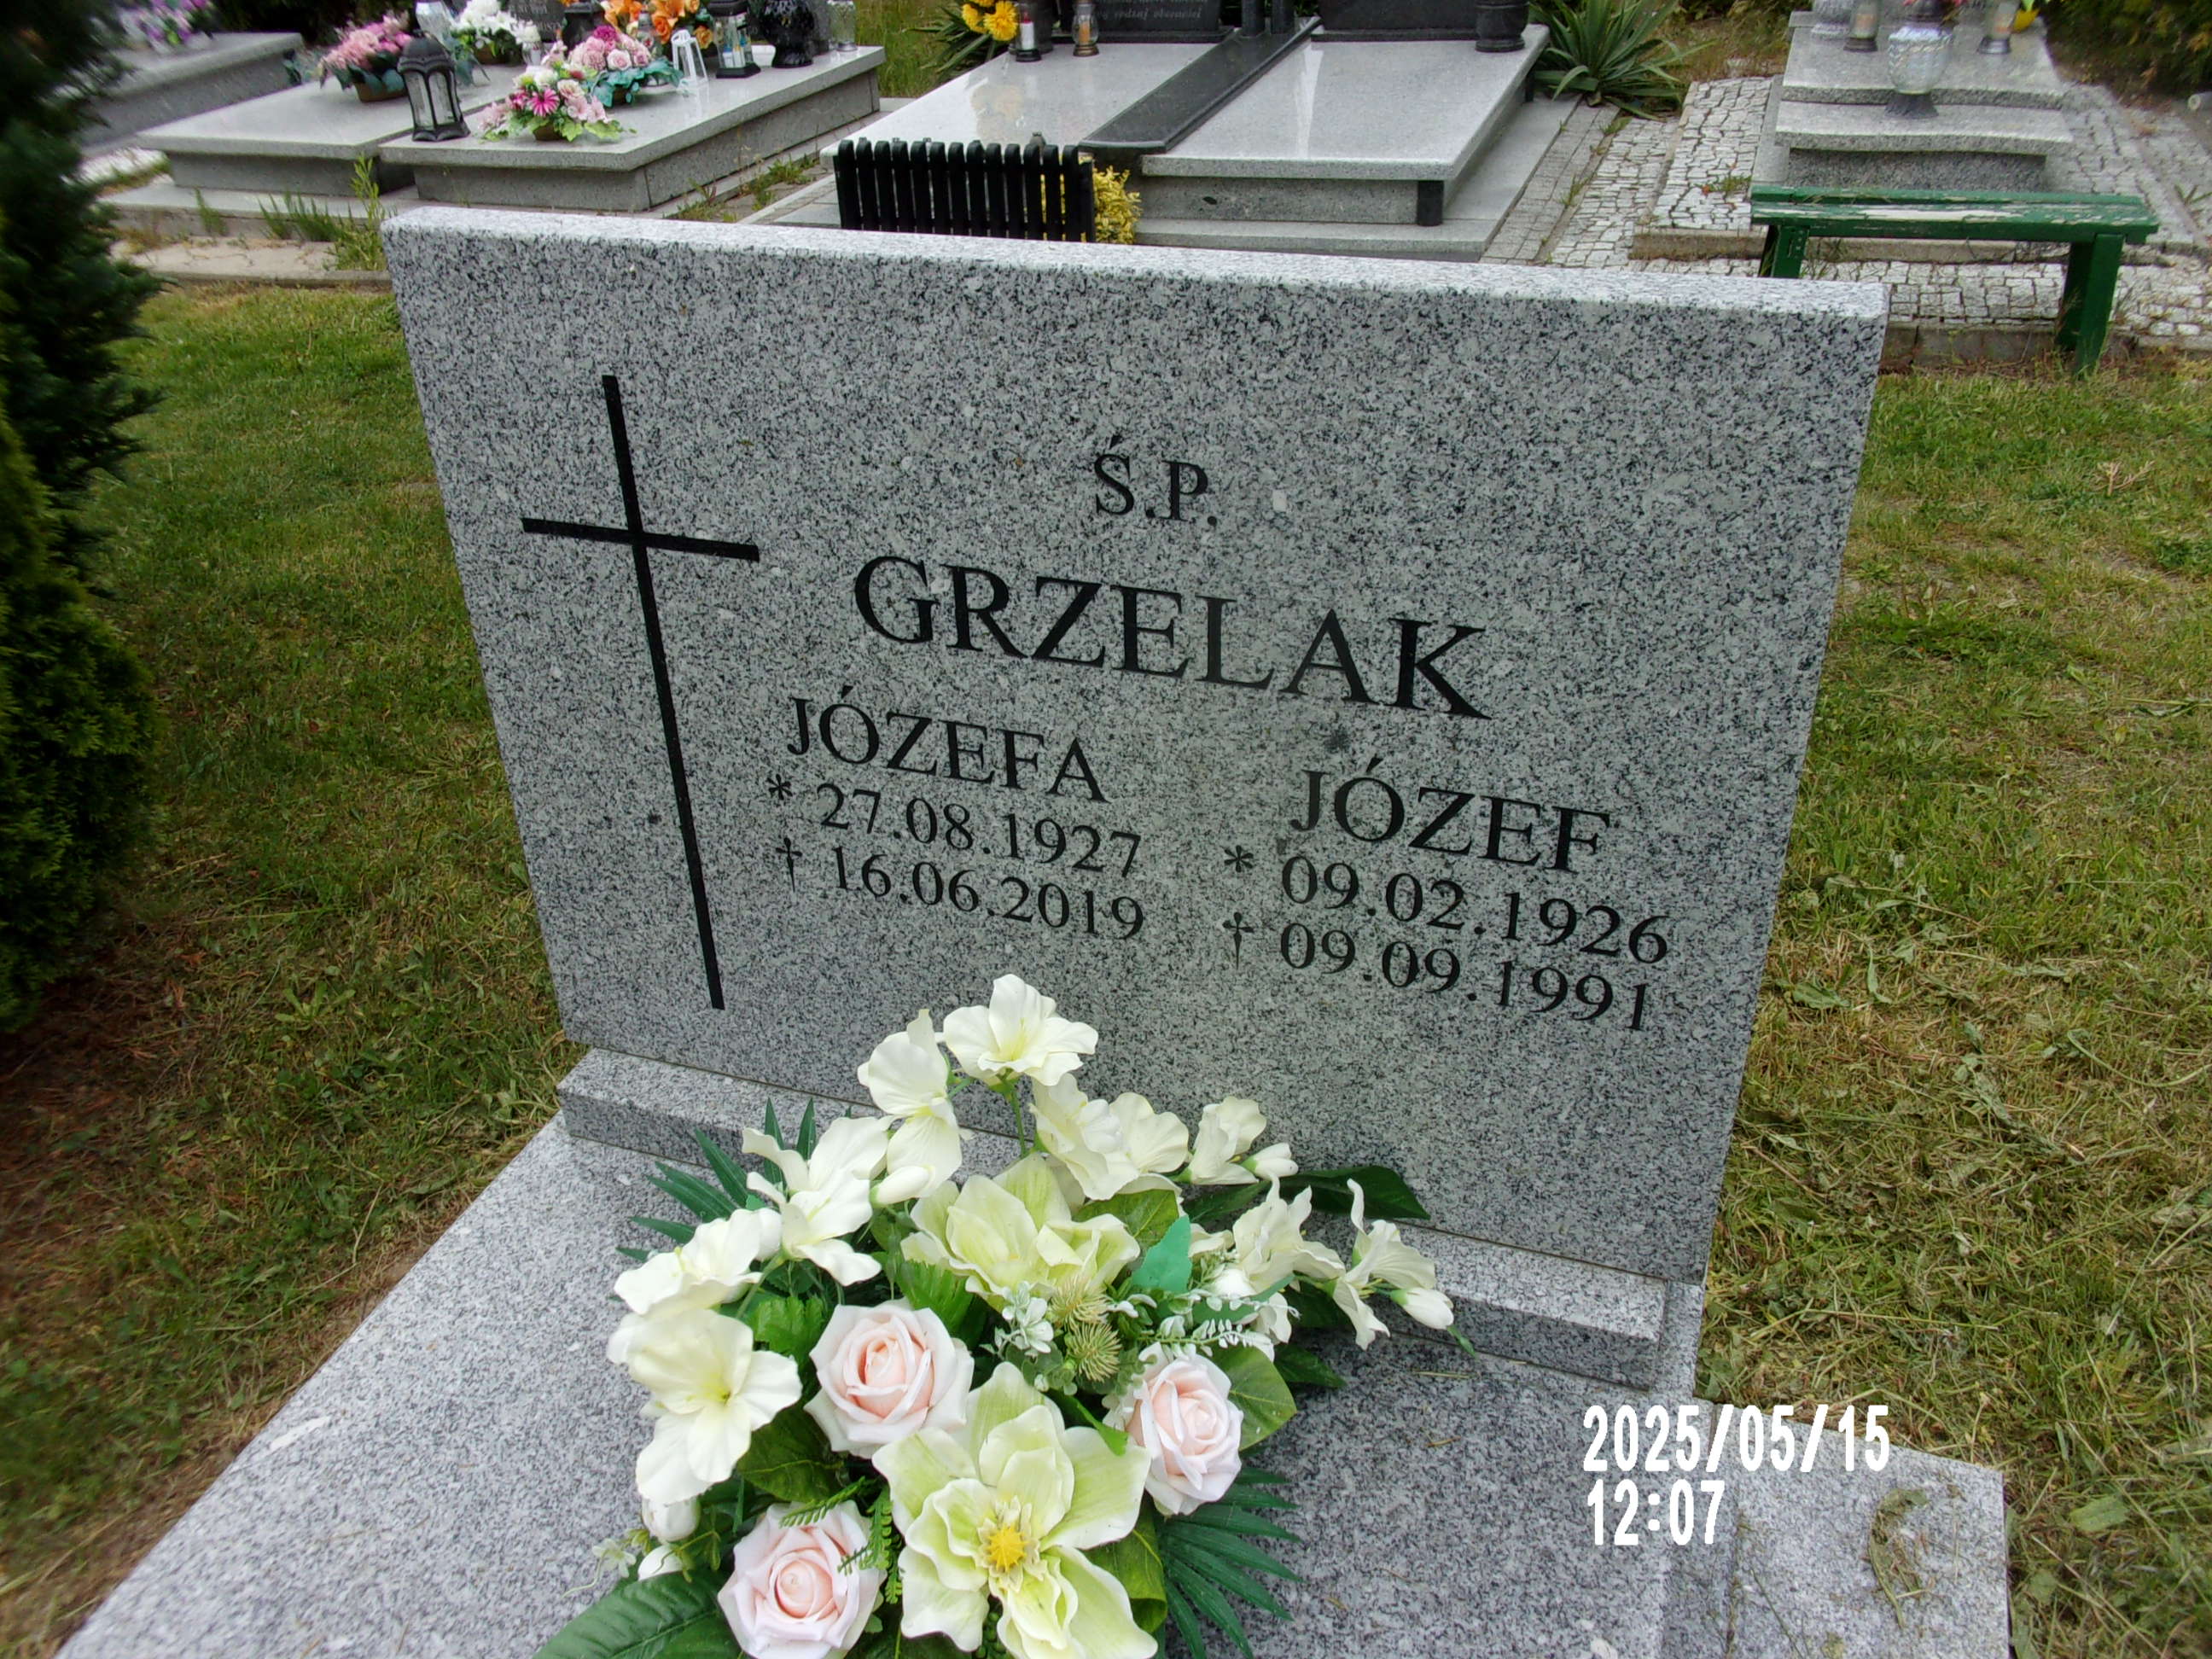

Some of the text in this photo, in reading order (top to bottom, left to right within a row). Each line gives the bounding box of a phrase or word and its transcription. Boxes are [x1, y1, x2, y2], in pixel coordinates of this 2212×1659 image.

[854, 556, 1492, 719] GRZELAK
[787, 685, 1111, 803] JÓZEFA
[816, 783, 1141, 878] 27.08.1927
[1290, 757, 1610, 873] JÓZEF
[833, 846, 1144, 939] 16.06.2019
[1282, 856, 1670, 964] 09.02.1926
[1280, 923, 1648, 1031] 09.09.1991
